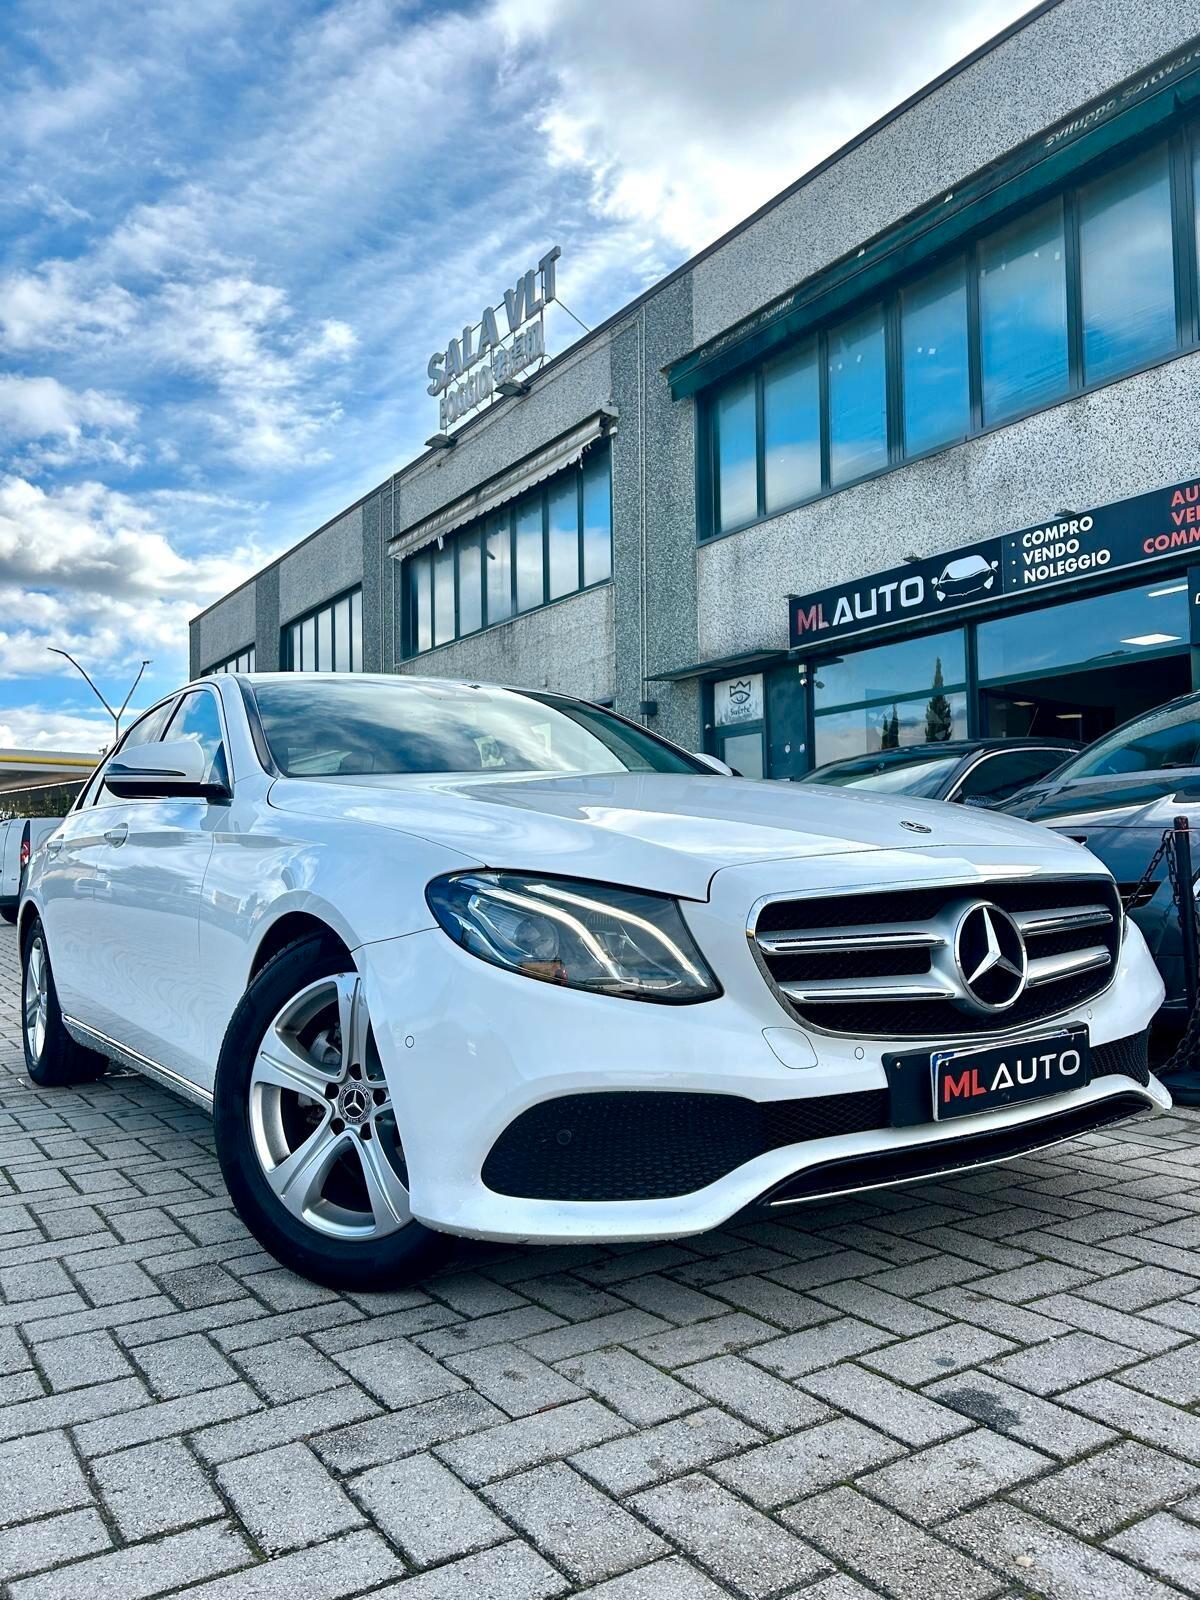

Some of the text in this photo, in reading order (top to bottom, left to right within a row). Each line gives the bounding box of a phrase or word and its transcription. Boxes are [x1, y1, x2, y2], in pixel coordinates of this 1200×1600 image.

[1044, 99, 1116, 148] Sviluppo
[426, 306, 499, 397] SALA
[503, 245, 561, 333] VLT
[1171, 485, 1200, 507] AU
[1022, 516, 1093, 548] COMPRO
[1022, 538, 1080, 565] VENDO
[1024, 549, 1111, 584] NOLEGGIO
